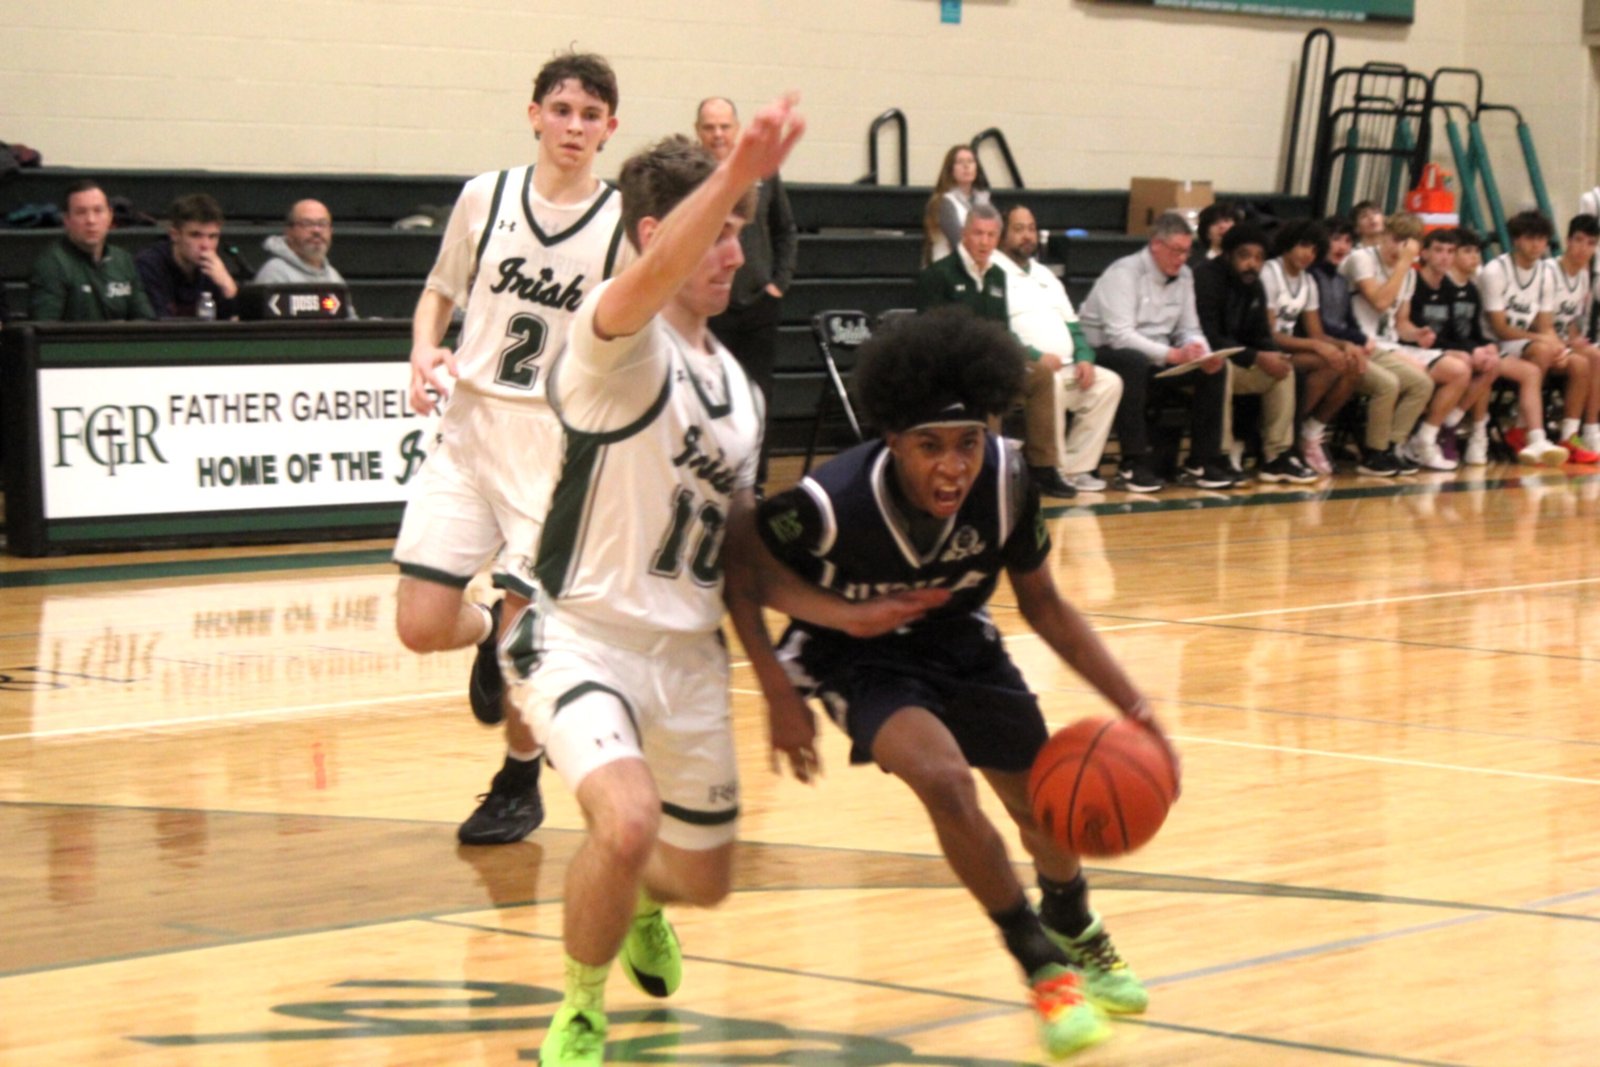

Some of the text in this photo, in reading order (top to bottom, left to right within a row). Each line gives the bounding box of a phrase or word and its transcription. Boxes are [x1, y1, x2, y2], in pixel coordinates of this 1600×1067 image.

[490, 257, 584, 313] Irish
[495, 312, 548, 391] 2
[169, 392, 281, 426] FATHER
[292, 389, 416, 422] GABRIEL
[51, 404, 169, 470] FGR
[197, 455, 279, 488] HOME
[287, 452, 322, 484] OF
[331, 450, 383, 481] THE
